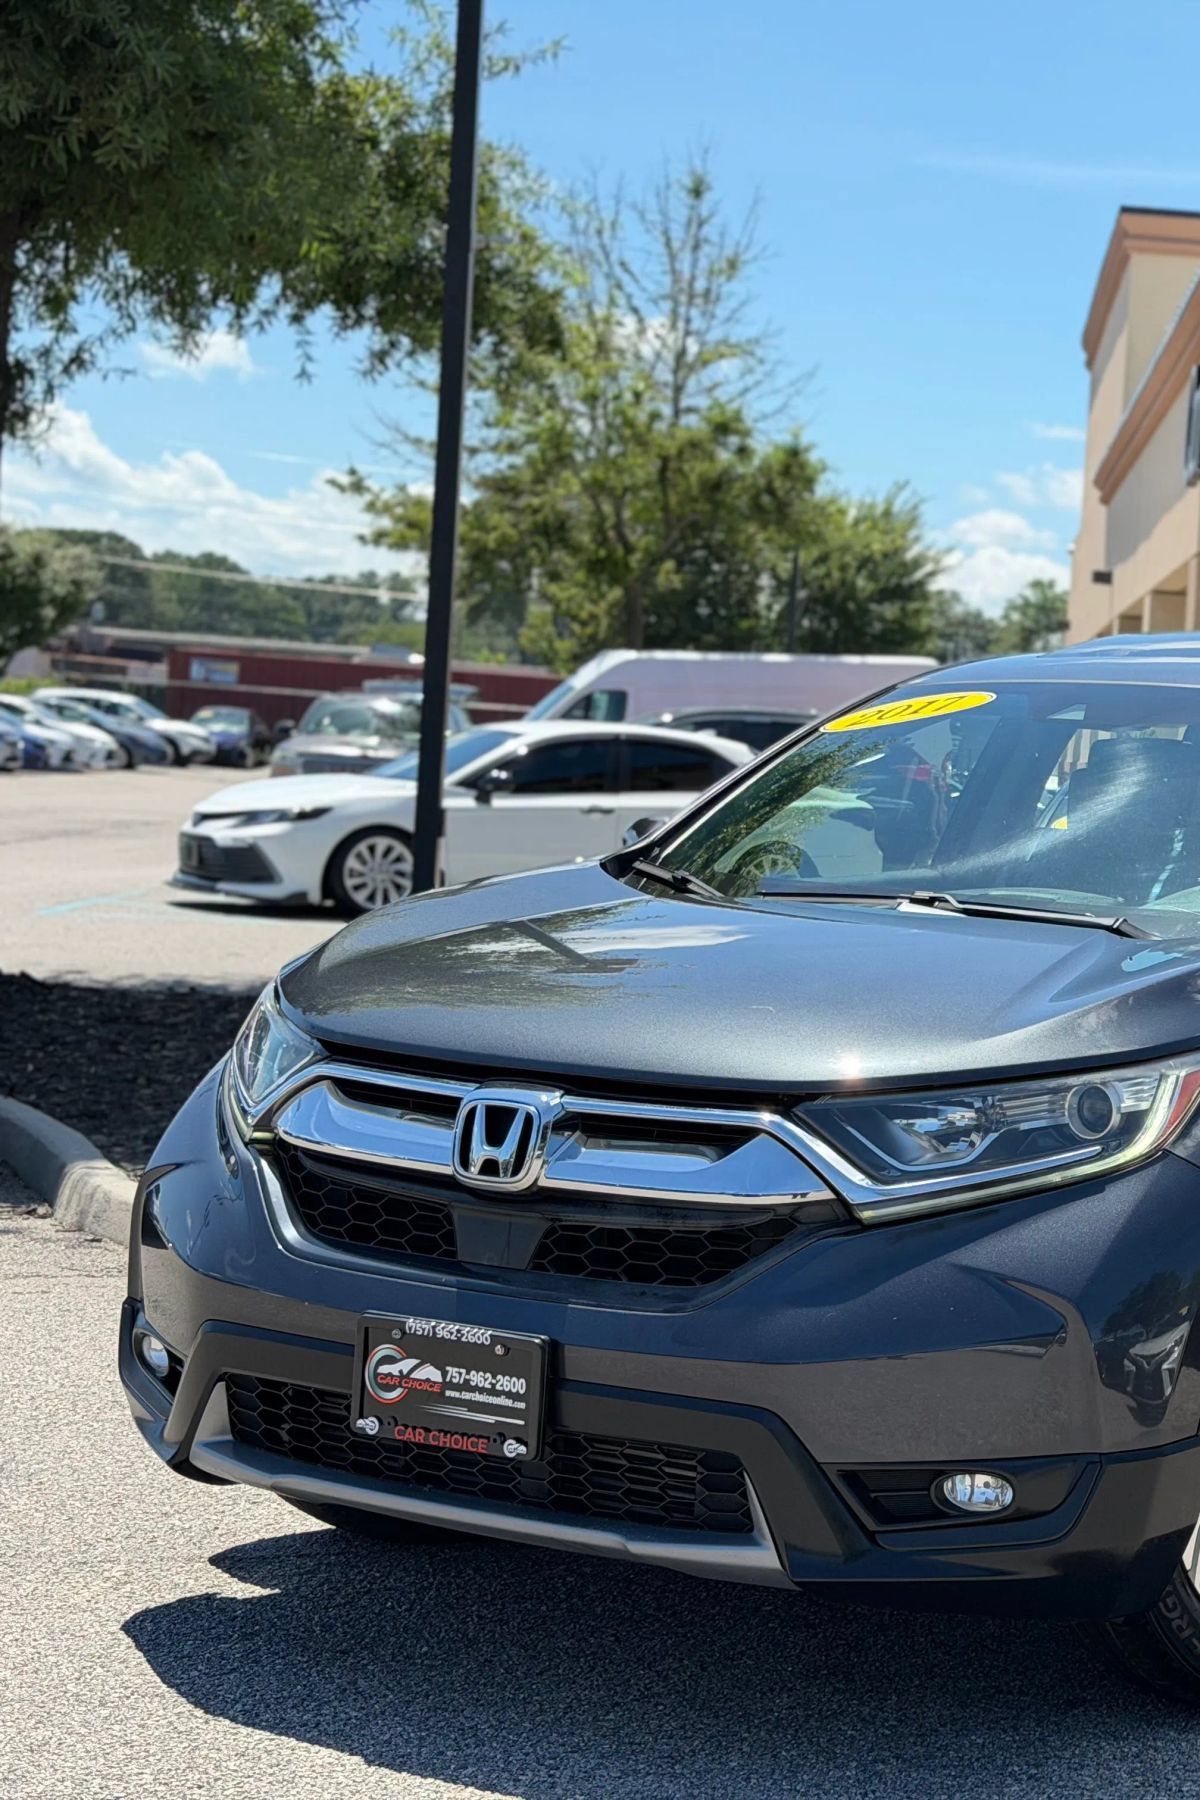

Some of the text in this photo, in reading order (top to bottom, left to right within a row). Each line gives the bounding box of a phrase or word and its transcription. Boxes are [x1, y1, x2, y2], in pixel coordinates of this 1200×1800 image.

[846, 695, 969, 727] 2017
[405, 1319, 491, 1345] (757) 962-2600
[376, 1374, 443, 1393] CAR CHOICE
[445, 1365, 527, 1395] 757-962-2600
[445, 1389, 526, 1410] www.carchoiceonline.com
[394, 1425, 488, 1454] CAR CHOICE
